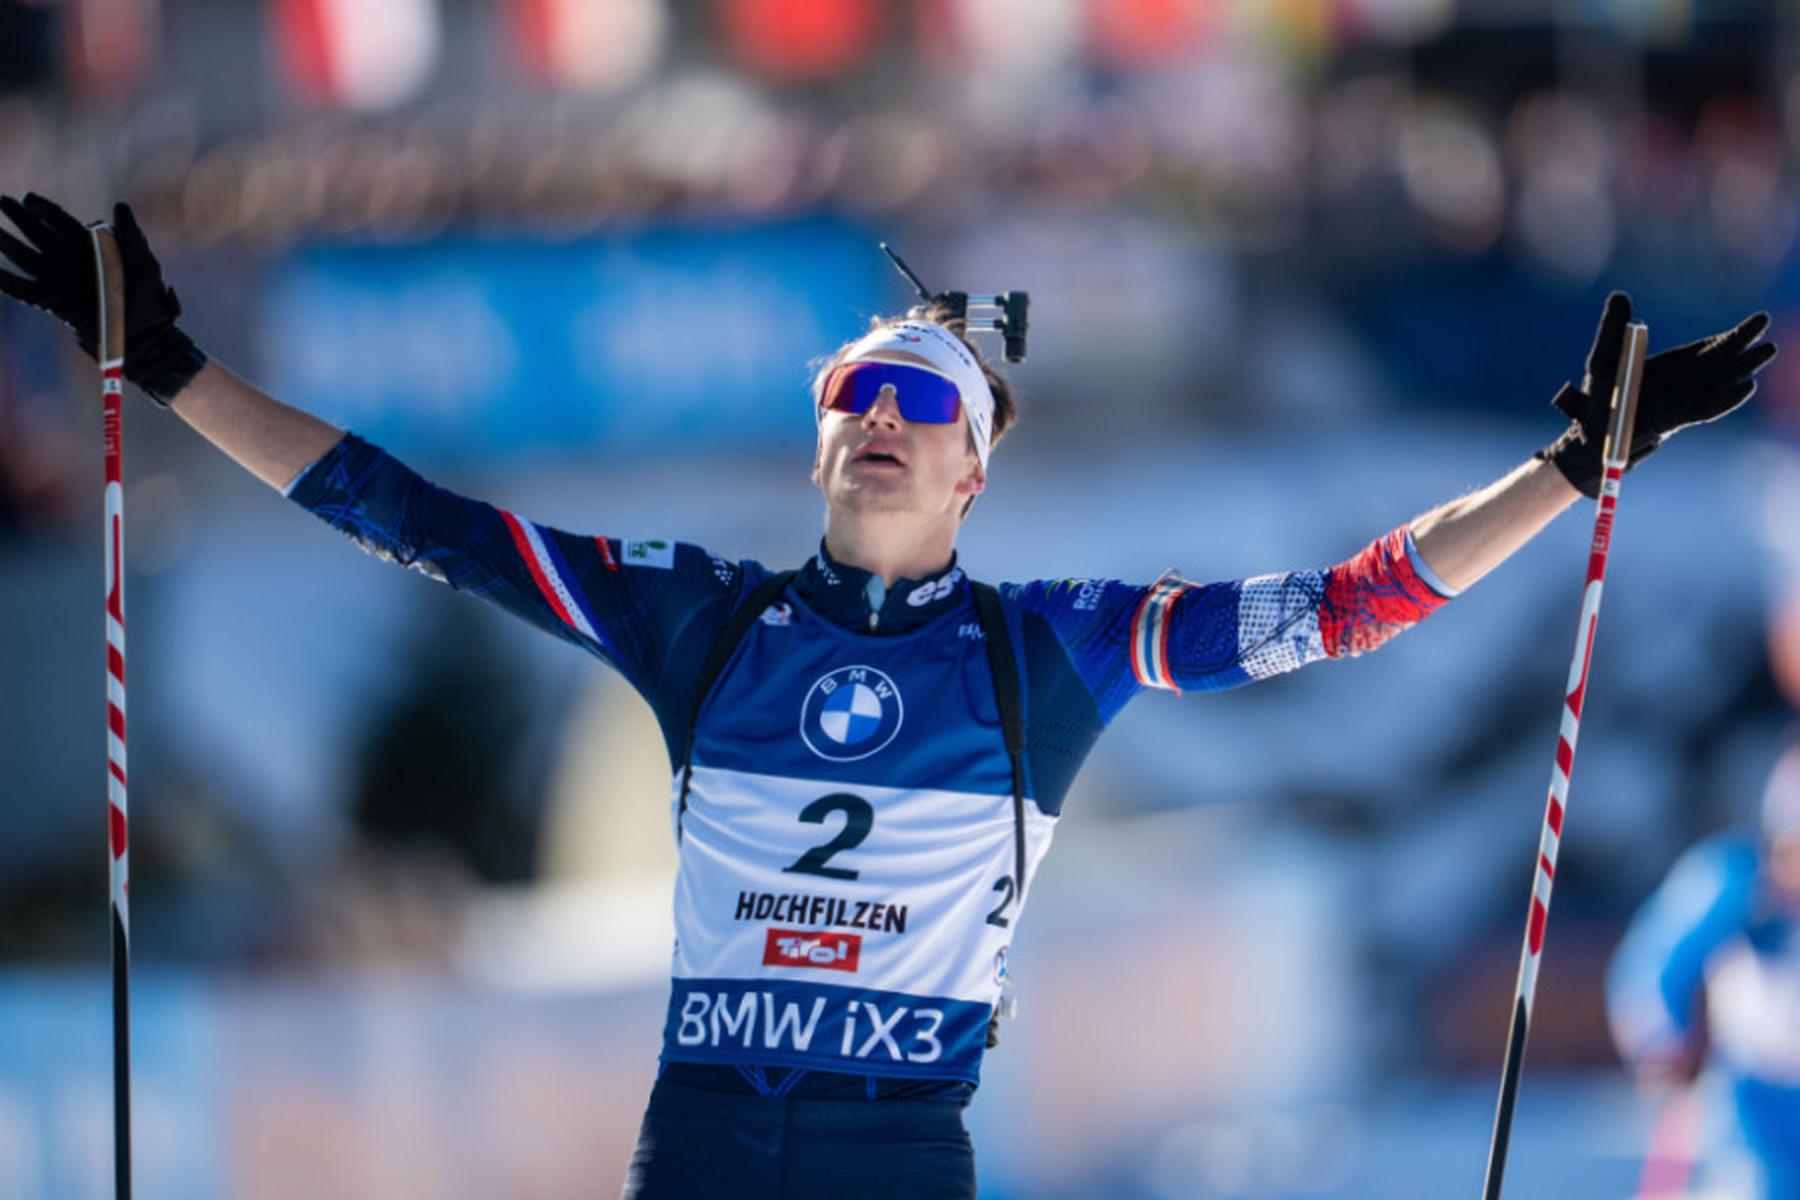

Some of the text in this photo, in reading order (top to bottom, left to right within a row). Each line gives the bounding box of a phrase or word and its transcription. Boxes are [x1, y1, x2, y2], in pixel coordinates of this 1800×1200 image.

[820, 669, 893, 699] BMW
[782, 792, 874, 881] 2
[734, 891, 908, 934] HOCHFILZEN
[986, 875, 1015, 929] 2
[677, 991, 945, 1064] BMW iX3
